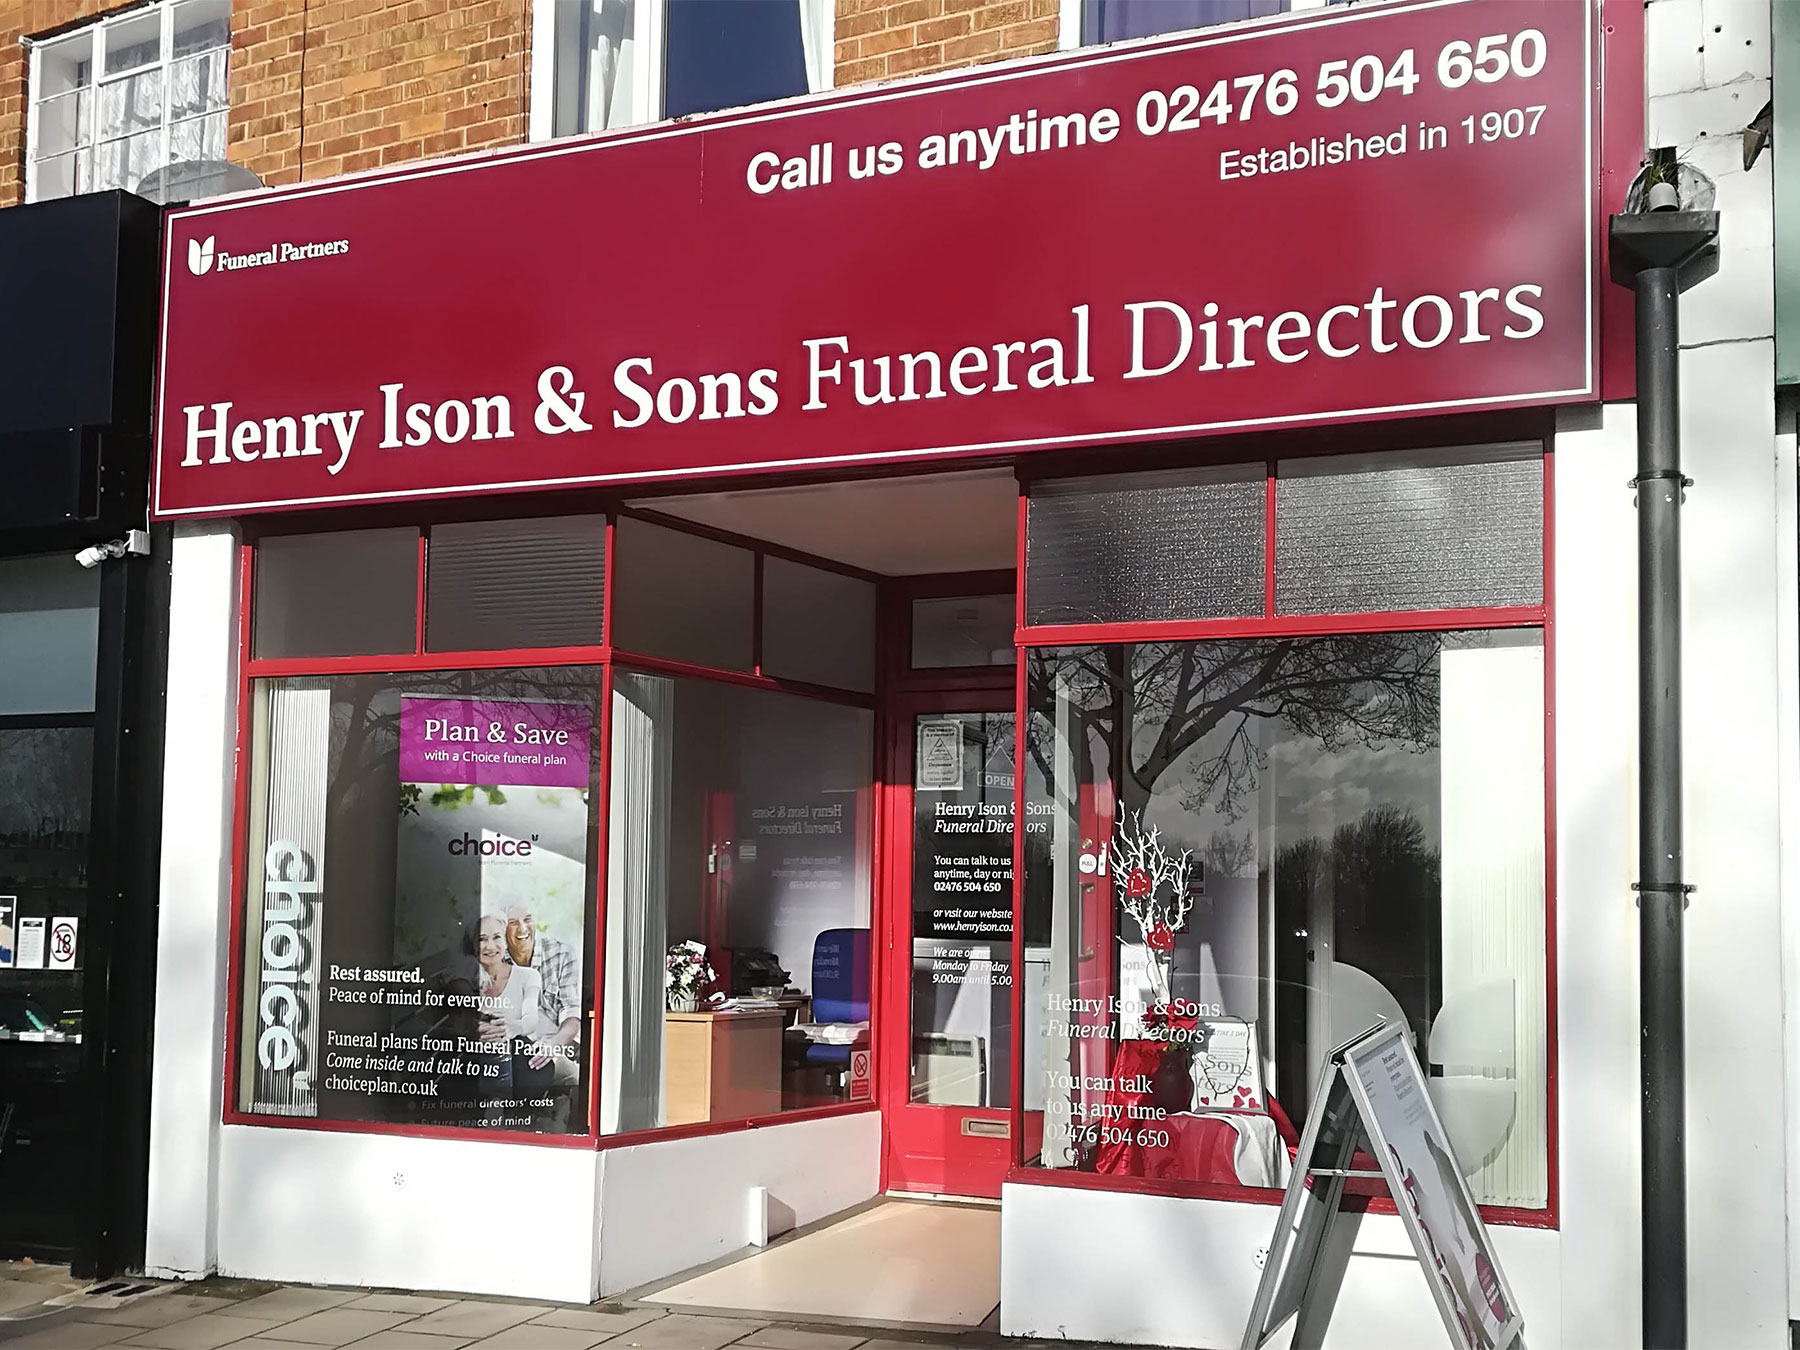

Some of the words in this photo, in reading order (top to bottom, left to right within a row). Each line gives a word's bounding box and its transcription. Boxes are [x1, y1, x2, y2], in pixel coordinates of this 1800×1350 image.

[746, 142, 833, 194] Call
[848, 140, 904, 180] us
[918, 105, 1120, 171] anytime
[1136, 68, 1299, 136] 02476
[1315, 48, 1420, 108] 504
[1436, 28, 1548, 90] 650
[1219, 124, 1407, 181] Established
[1419, 121, 1448, 151] in
[1461, 105, 1548, 145] 1907
[216, 243, 278, 272] Funeral
[279, 239, 349, 263] Partners
[180, 401, 364, 475] Henry
[379, 383, 512, 450] Ison
[533, 365, 593, 434] &
[612, 356, 779, 429] Sons
[802, 304, 1095, 411] Funeral
[1122, 282, 1546, 380] Directors
[424, 719, 480, 742] Plan
[486, 721, 507, 743] &
[513, 722, 569, 746] Save
[424, 750, 450, 762] with
[452, 752, 460, 763] a
[462, 751, 501, 763] Choice
[503, 752, 541, 765] funeral
[543, 755, 567, 767] plan
[985, 774, 1014, 787] OPEN
[934, 801, 976, 819] Henry
[977, 802, 1008, 816] Ison
[1026, 801, 1056, 815] Sons
[934, 819, 984, 834] Funeral
[986, 819, 1047, 834] Direors
[448, 831, 532, 857] choice
[934, 855, 952, 866] You
[953, 857, 969, 867] can
[970, 855, 989, 867] talk
[989, 857, 999, 867] to
[1000, 857, 1012, 867] us
[934, 868, 973, 881] anytime,
[974, 869, 990, 882] day
[991, 872, 1003, 880] or
[934, 881, 963, 893] 02476
[963, 881, 982, 893] 504
[983, 881, 1002, 893] 650
[933, 909, 944, 918] or
[944, 908, 962, 919] visit
[964, 910, 979, 919] our
[979, 907, 1013, 919] website
[933, 920, 1014, 934] www.henryison.co.
[258, 838, 318, 1072] choice
[933, 946, 948, 958] We
[948, 948, 964, 958] are
[329, 964, 361, 981] Rest
[363, 967, 425, 983] assured.
[932, 959, 969, 973] Monday
[970, 961, 979, 971] to
[981, 961, 1009, 974] Friday
[932, 973, 967, 984] 9.00am
[968, 975, 990, 985] until
[991, 975, 1014, 988] 5.00
[328, 986, 367, 1003] Peace
[369, 988, 385, 1004] of
[386, 989, 422, 1005] mind
[424, 990, 445, 1006] for
[447, 993, 514, 1011] everyone.
[1047, 993, 1104, 1016] Henry
[1107, 995, 1148, 1015] Ison
[1153, 998, 1169, 1014] &
[1173, 998, 1221, 1017] Sons
[1047, 1019, 1117, 1040] Funeral
[1121, 1022, 1205, 1043] Dectors
[327, 1030, 378, 1048] Funeral
[380, 1032, 418, 1052] plans
[421, 1034, 454, 1052] from
[457, 1037, 512, 1055] Funeral
[514, 1039, 575, 1057] Partners
[326, 1052, 363, 1069] Come
[365, 1054, 405, 1071] inside
[407, 1056, 435, 1073] and
[437, 1058, 463, 1075] talk
[466, 1060, 480, 1076] to
[483, 1064, 500, 1077] us
[325, 1073, 439, 1096] choiceplan.co.uk
[1047, 1070, 1080, 1090] You
[1084, 1075, 1115, 1091] can
[1119, 1074, 1153, 1093] talk
[422, 1100, 436, 1110] Fix
[439, 1099, 477, 1110] funeral
[529, 1096, 554, 1107] costs
[1047, 1099, 1063, 1114] to
[1069, 1102, 1086, 1115] us
[1090, 1103, 1123, 1122] any
[1127, 1100, 1167, 1120] time
[490, 1115, 503, 1127] of
[504, 1114, 531, 1127] mind
[1046, 1123, 1098, 1143] 02476
[1100, 1126, 1133, 1146] 504
[1136, 1128, 1170, 1148] 650
